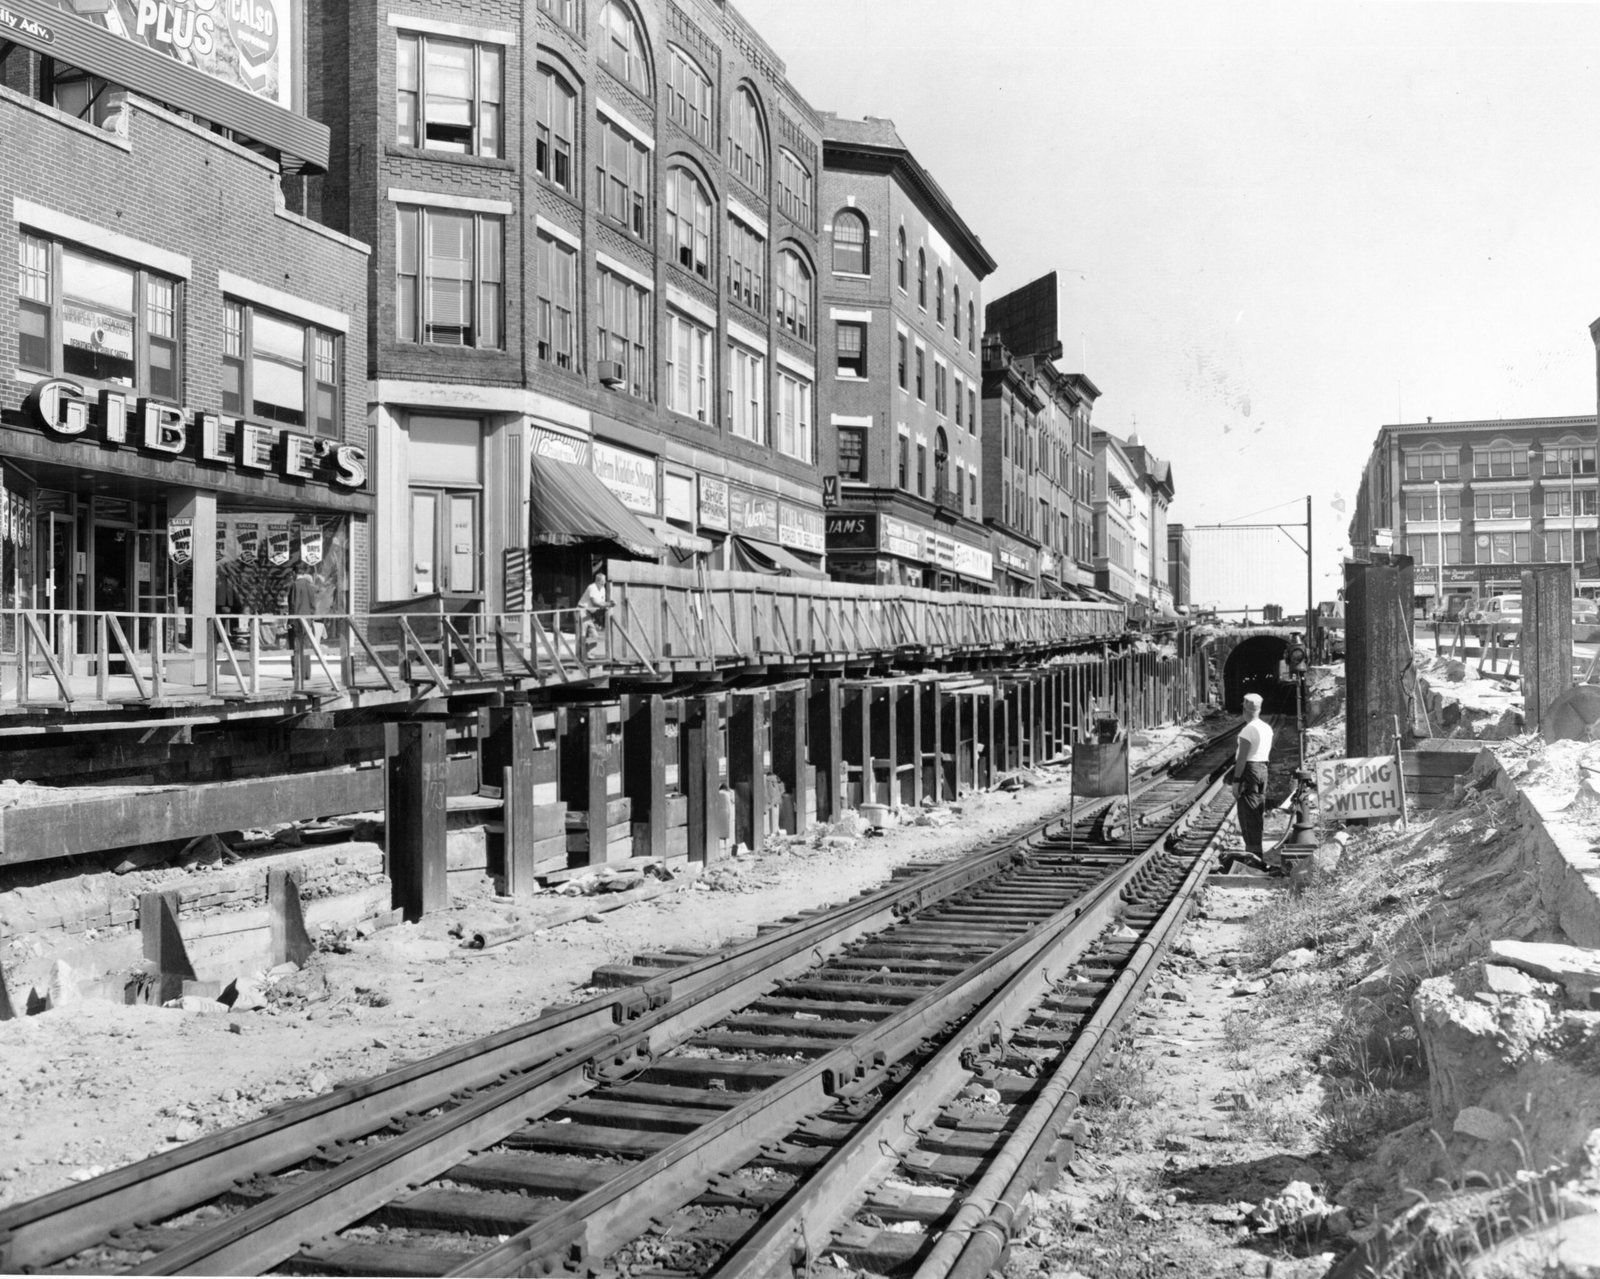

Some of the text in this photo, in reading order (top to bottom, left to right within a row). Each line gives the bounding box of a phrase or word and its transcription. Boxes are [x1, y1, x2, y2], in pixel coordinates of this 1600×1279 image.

[19, 18, 49, 39] Adv.
[136, 0, 214, 55] PLUS
[231, 0, 273, 36] CALSO
[704, 488, 724, 506] SHOE
[825, 519, 865, 534] IAMS
[1322, 764, 1392, 787] SPRING
[1323, 790, 1396, 812] SWITCH
